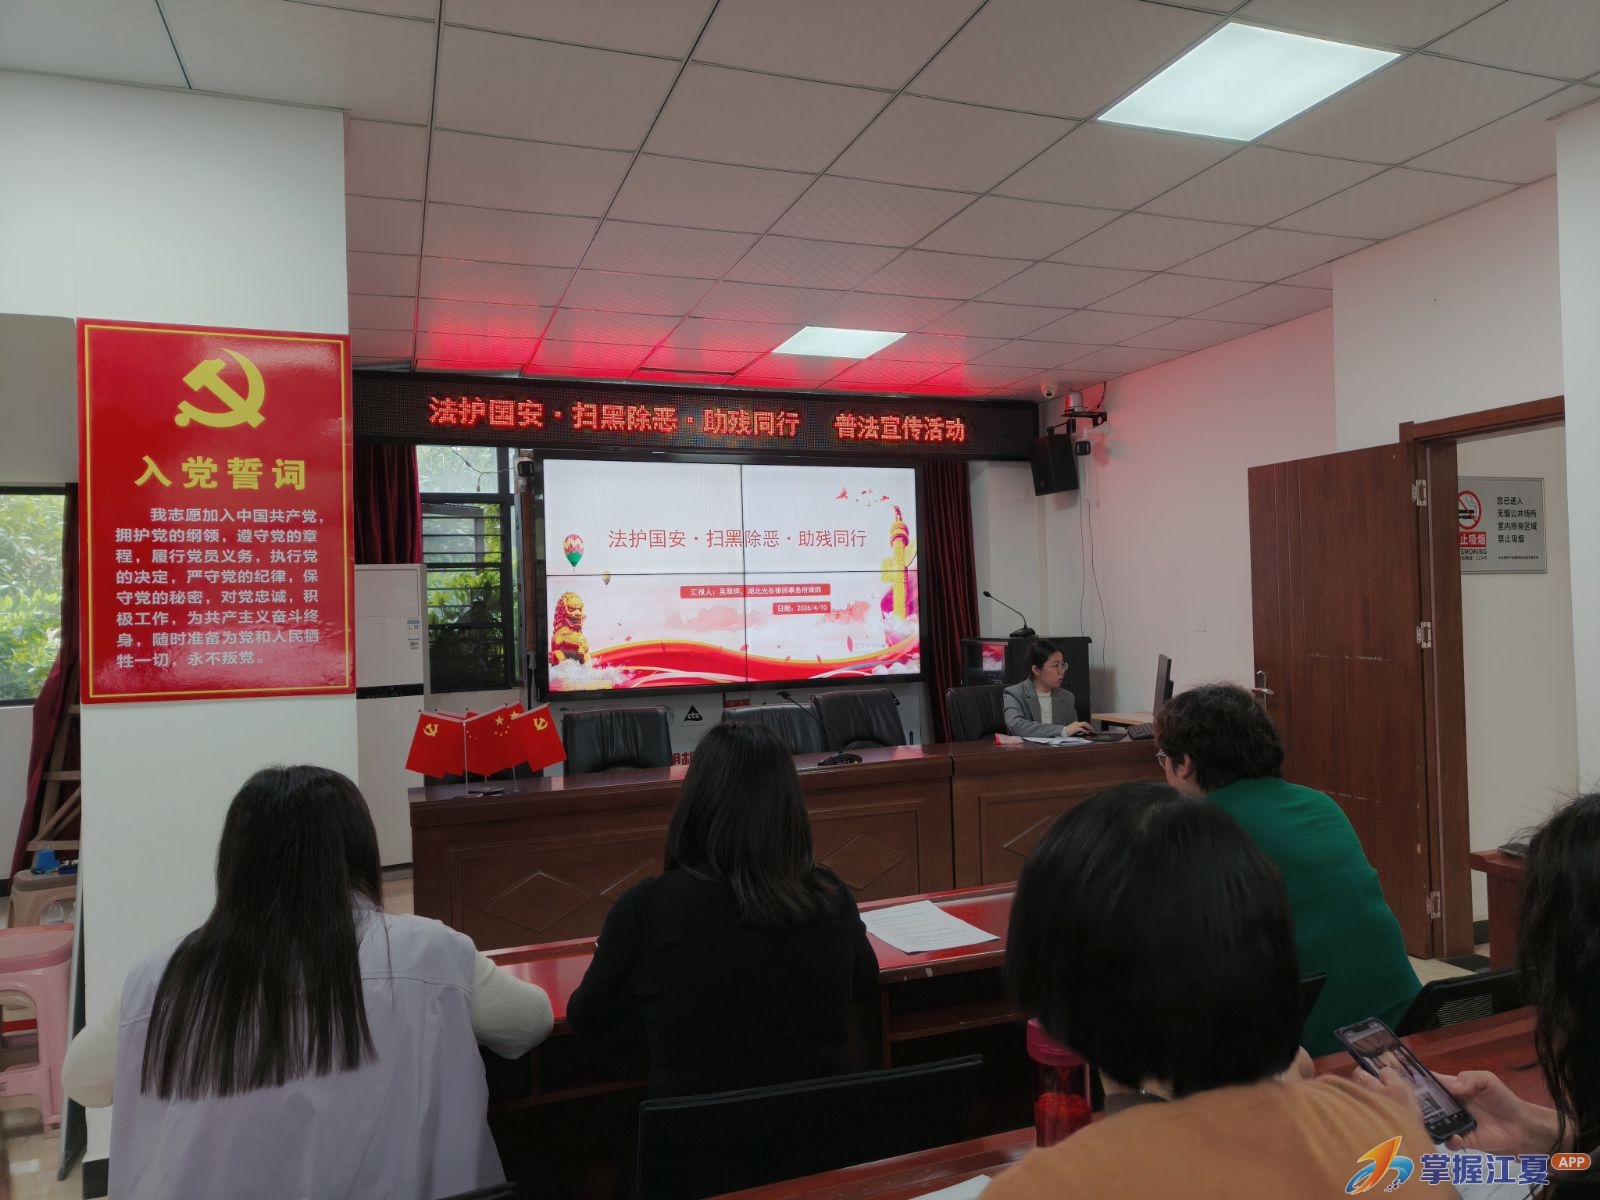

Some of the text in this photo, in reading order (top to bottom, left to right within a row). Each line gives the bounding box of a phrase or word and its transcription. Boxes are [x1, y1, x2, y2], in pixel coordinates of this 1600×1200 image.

[834, 413, 967, 442] 普法宣传活动
[134, 455, 306, 490] 入党誓词
[1497, 497, 1523, 505] 您已进入
[150, 508, 326, 524] 我志愿加入中国共产党，
[1497, 510, 1537, 518] 无烟公共场所
[1497, 522, 1537, 531] 室内所有区域
[1497, 534, 1525, 543] 禁止吸烟
